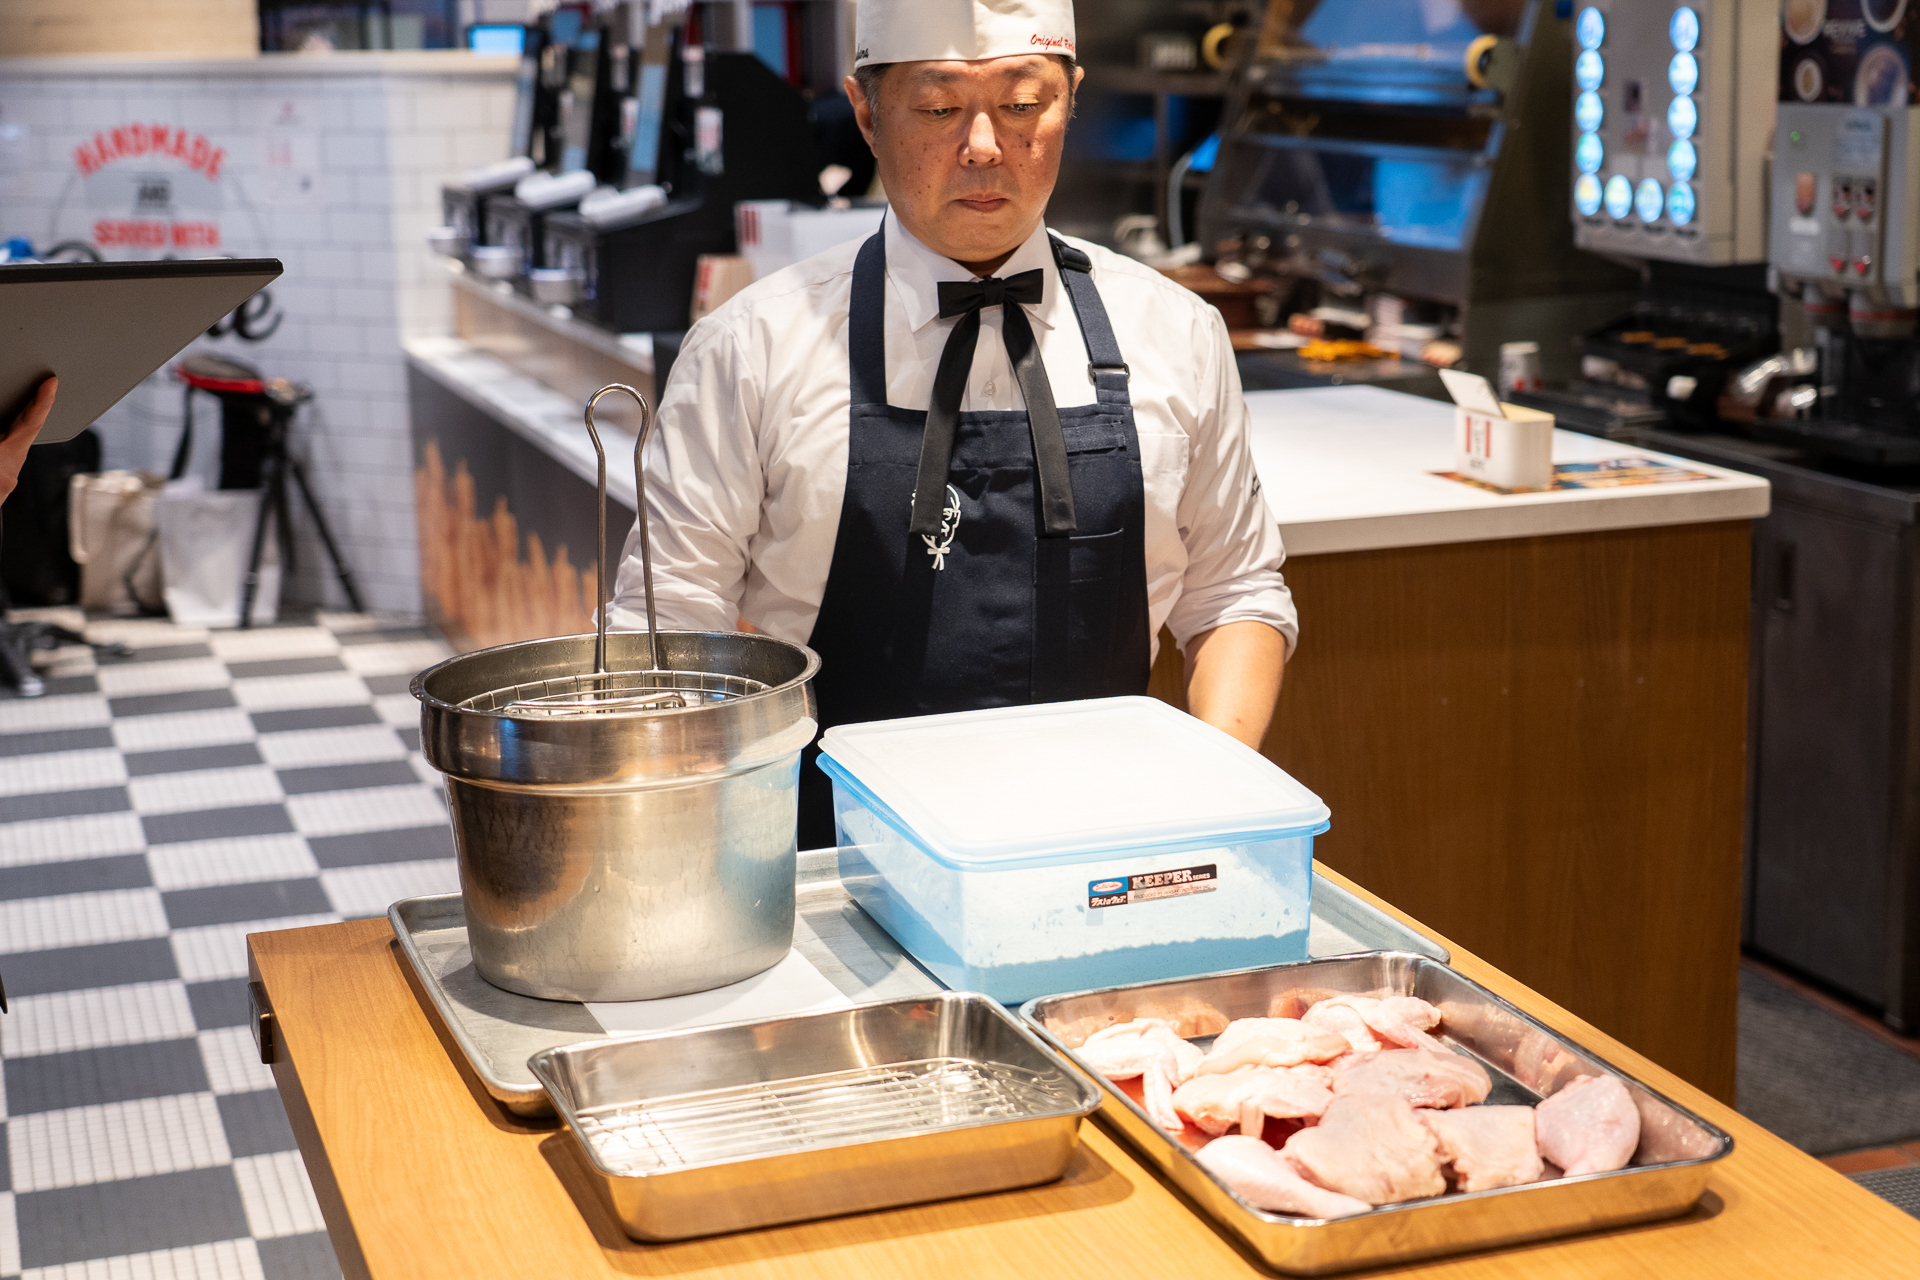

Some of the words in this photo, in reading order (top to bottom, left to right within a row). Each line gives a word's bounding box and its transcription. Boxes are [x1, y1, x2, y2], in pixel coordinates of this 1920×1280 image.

[1030, 34, 1063, 51] Original
[72, 122, 228, 183] HANDMADE
[1132, 870, 1192, 889] KEEPER
